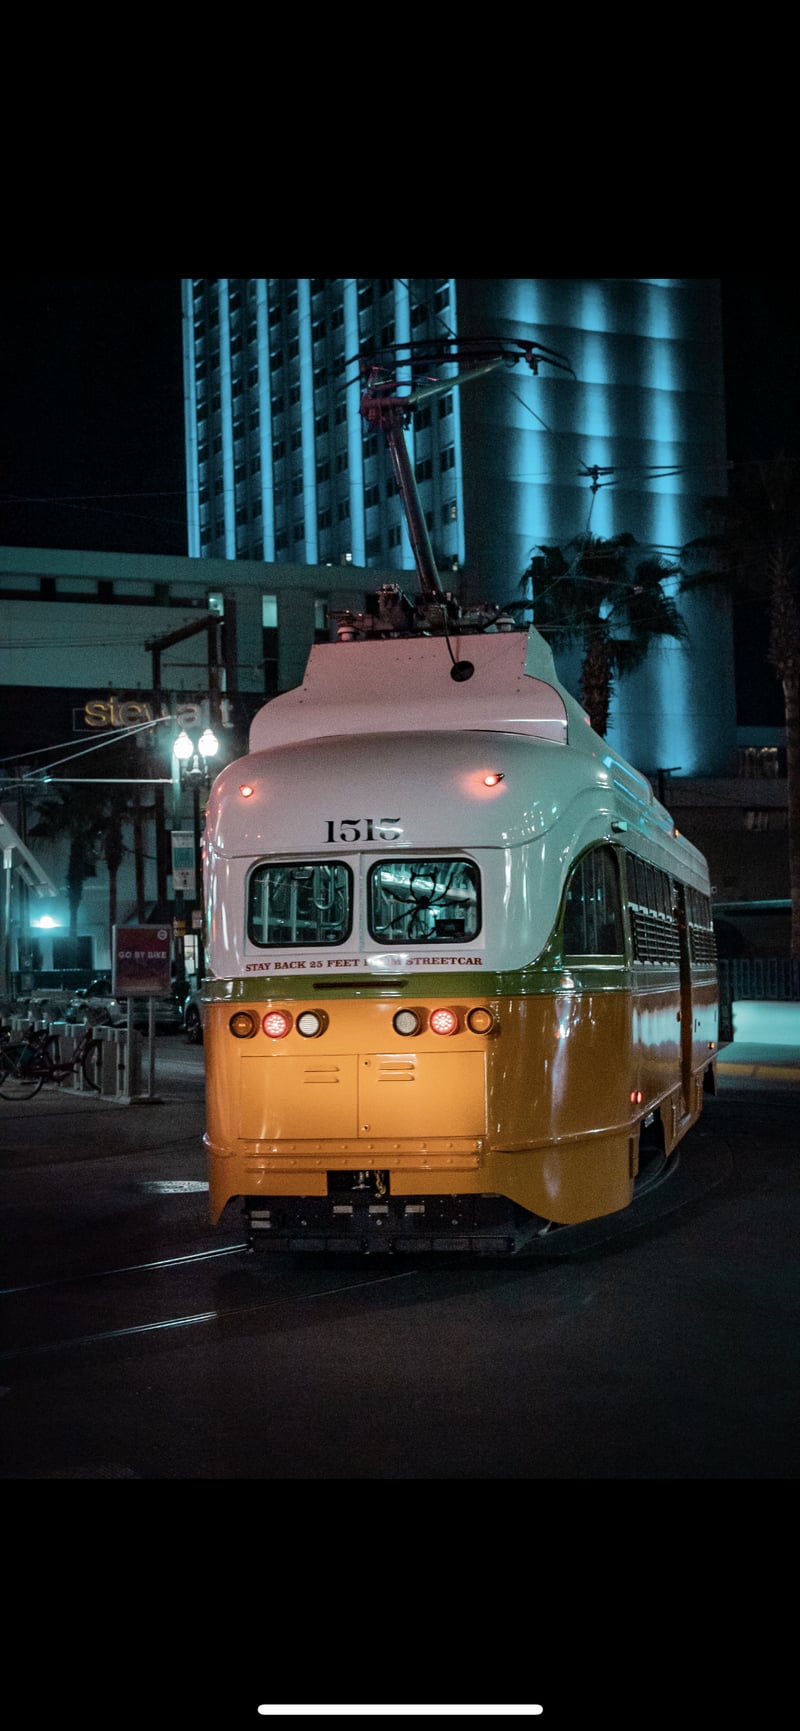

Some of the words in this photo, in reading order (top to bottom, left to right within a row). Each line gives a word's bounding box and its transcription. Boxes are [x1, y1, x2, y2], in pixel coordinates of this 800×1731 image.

[323, 818, 401, 843] 1515
[118, 951, 132, 959] GO
[134, 951, 146, 959] BY
[147, 951, 167, 959] BIKE
[245, 962, 271, 972] STAY
[274, 961, 306, 970] BACK
[310, 960, 323, 968] 25
[327, 959, 360, 968] FEET
[407, 957, 483, 966] STREETCAR
